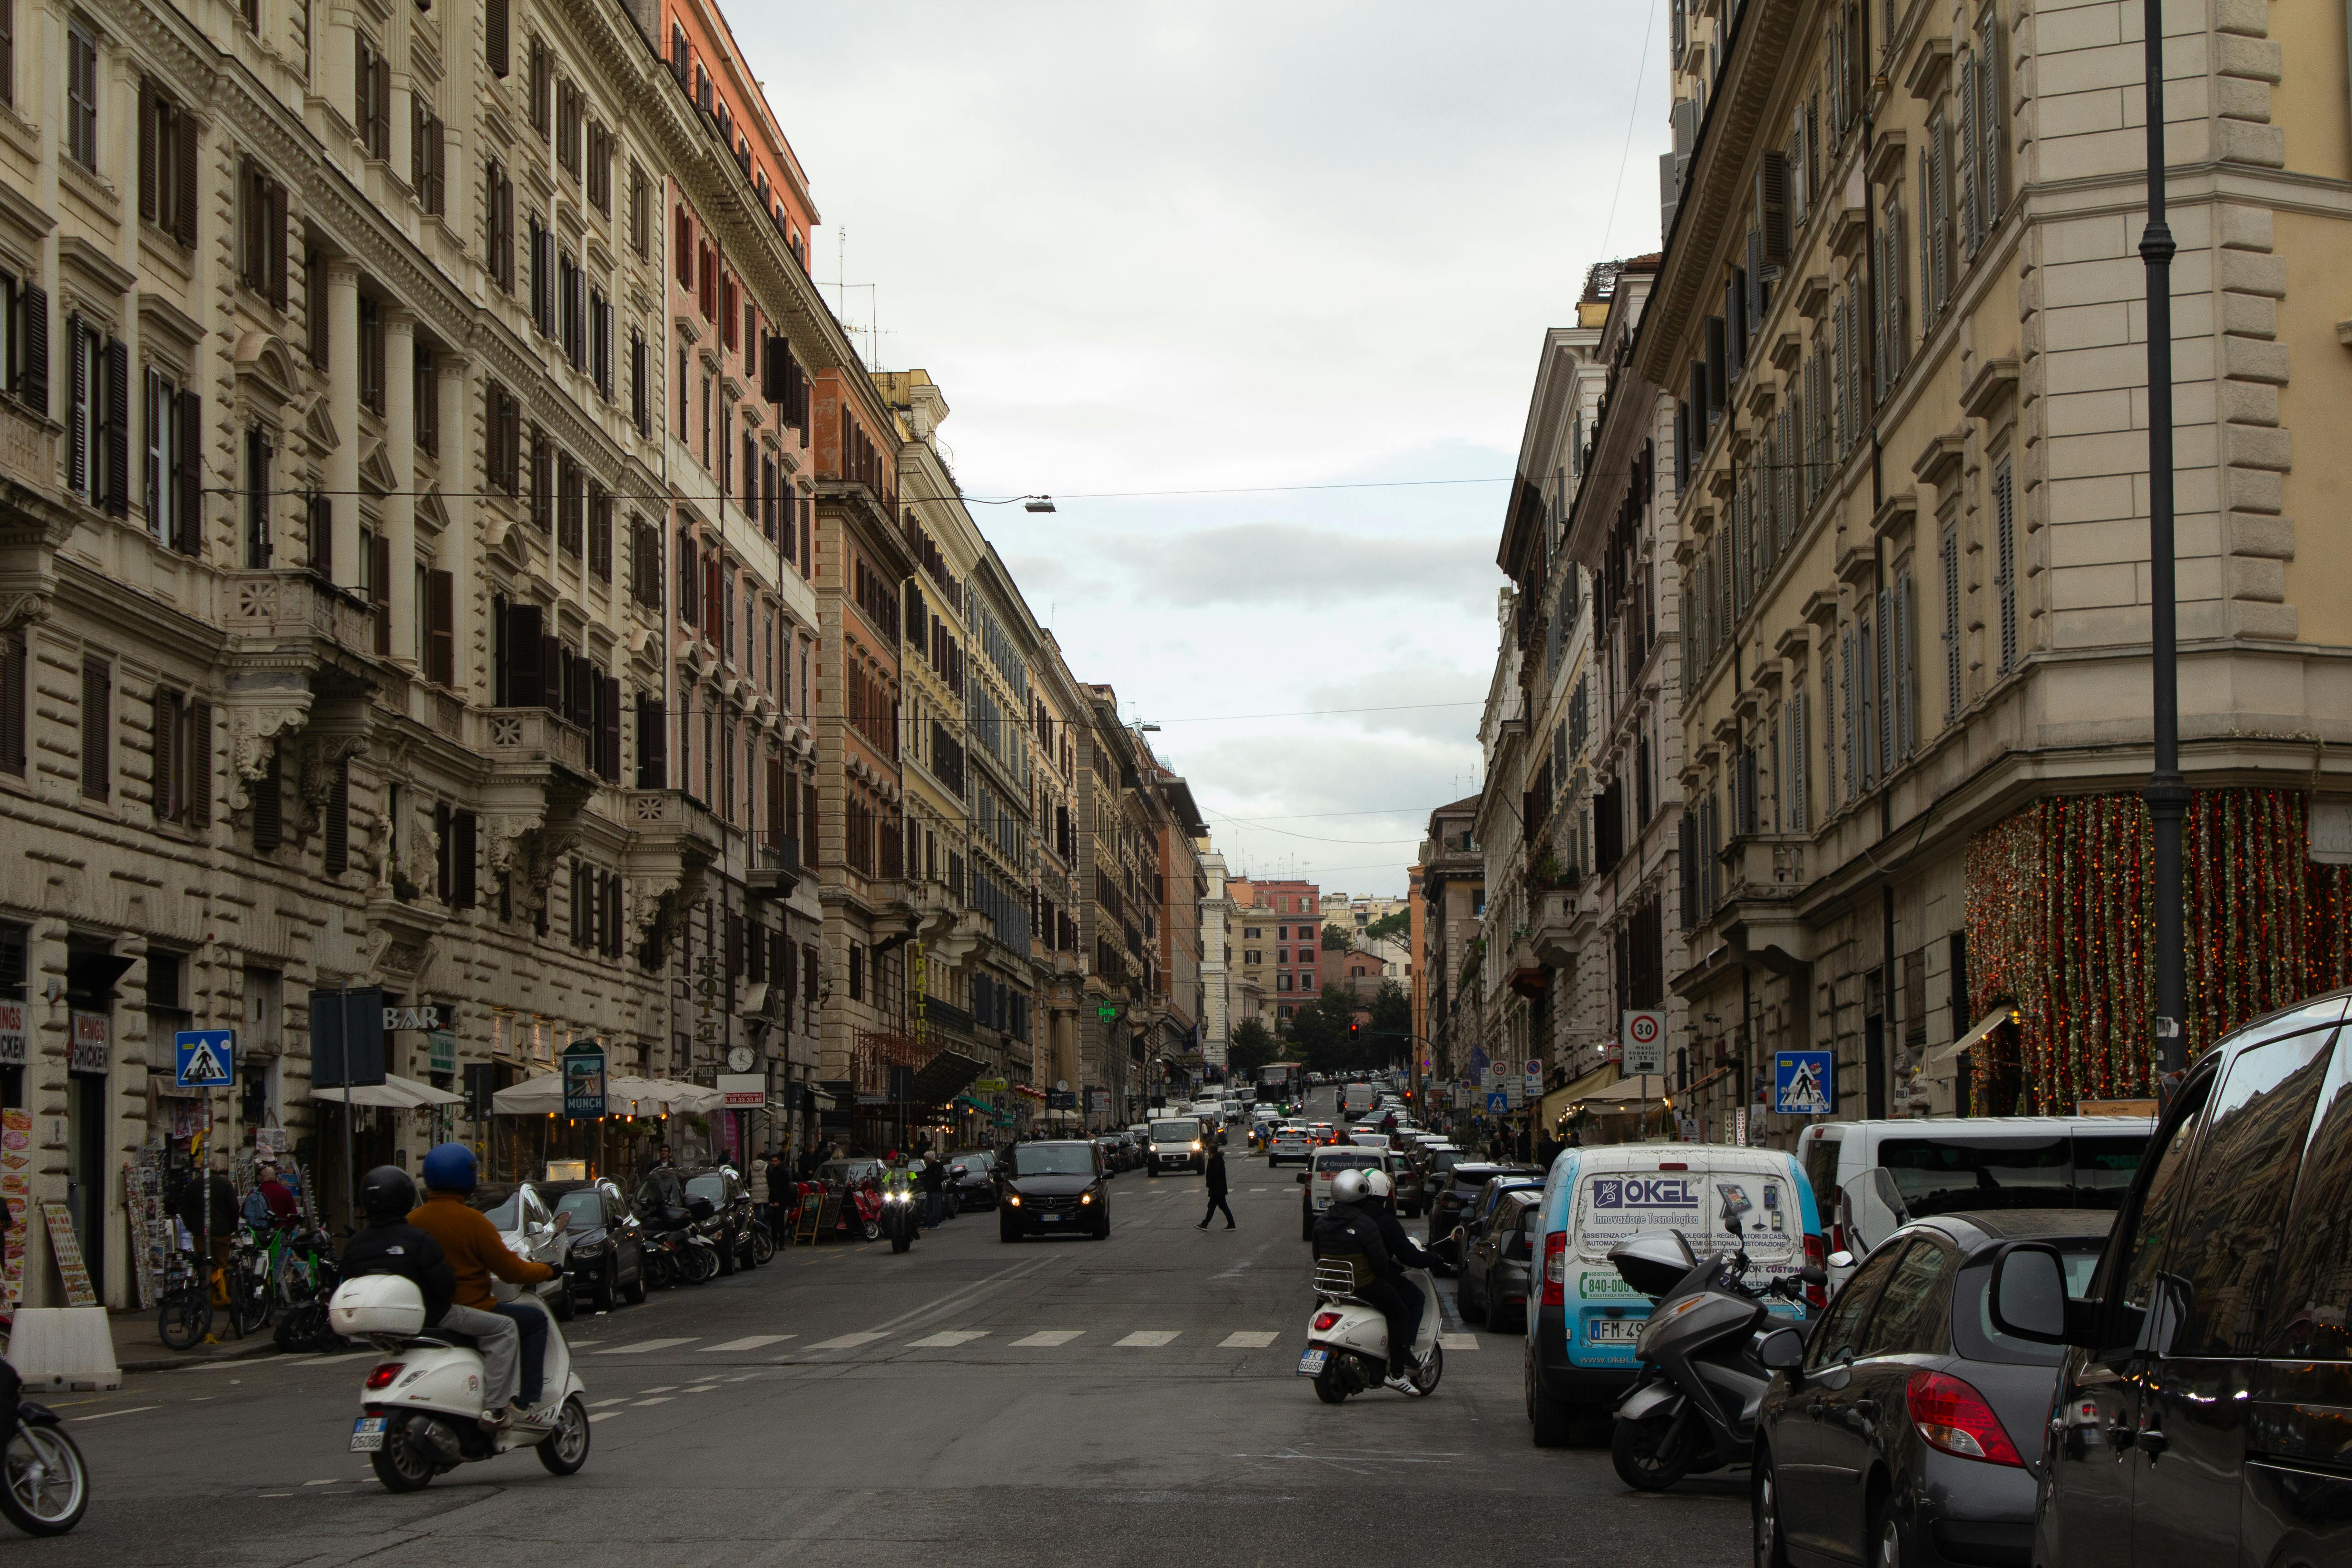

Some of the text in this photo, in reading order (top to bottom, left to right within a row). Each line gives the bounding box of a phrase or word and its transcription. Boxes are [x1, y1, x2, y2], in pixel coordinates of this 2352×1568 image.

[382, 1006, 439, 1030] BAR
[78, 1017, 105, 1042] WINGS
[1637, 1024, 1652, 1035] 30
[74, 1044, 108, 1068] CHICKEN
[698, 1066, 714, 1077] SOLIS
[568, 1098, 602, 1108] MUNCH
[1625, 1180, 1698, 1202] OKEL
[1593, 1212, 1699, 1227] Innovazione Tecnologica
[1299, 1360, 1322, 1371] 66658
[352, 1435, 381, 1449] 26088
